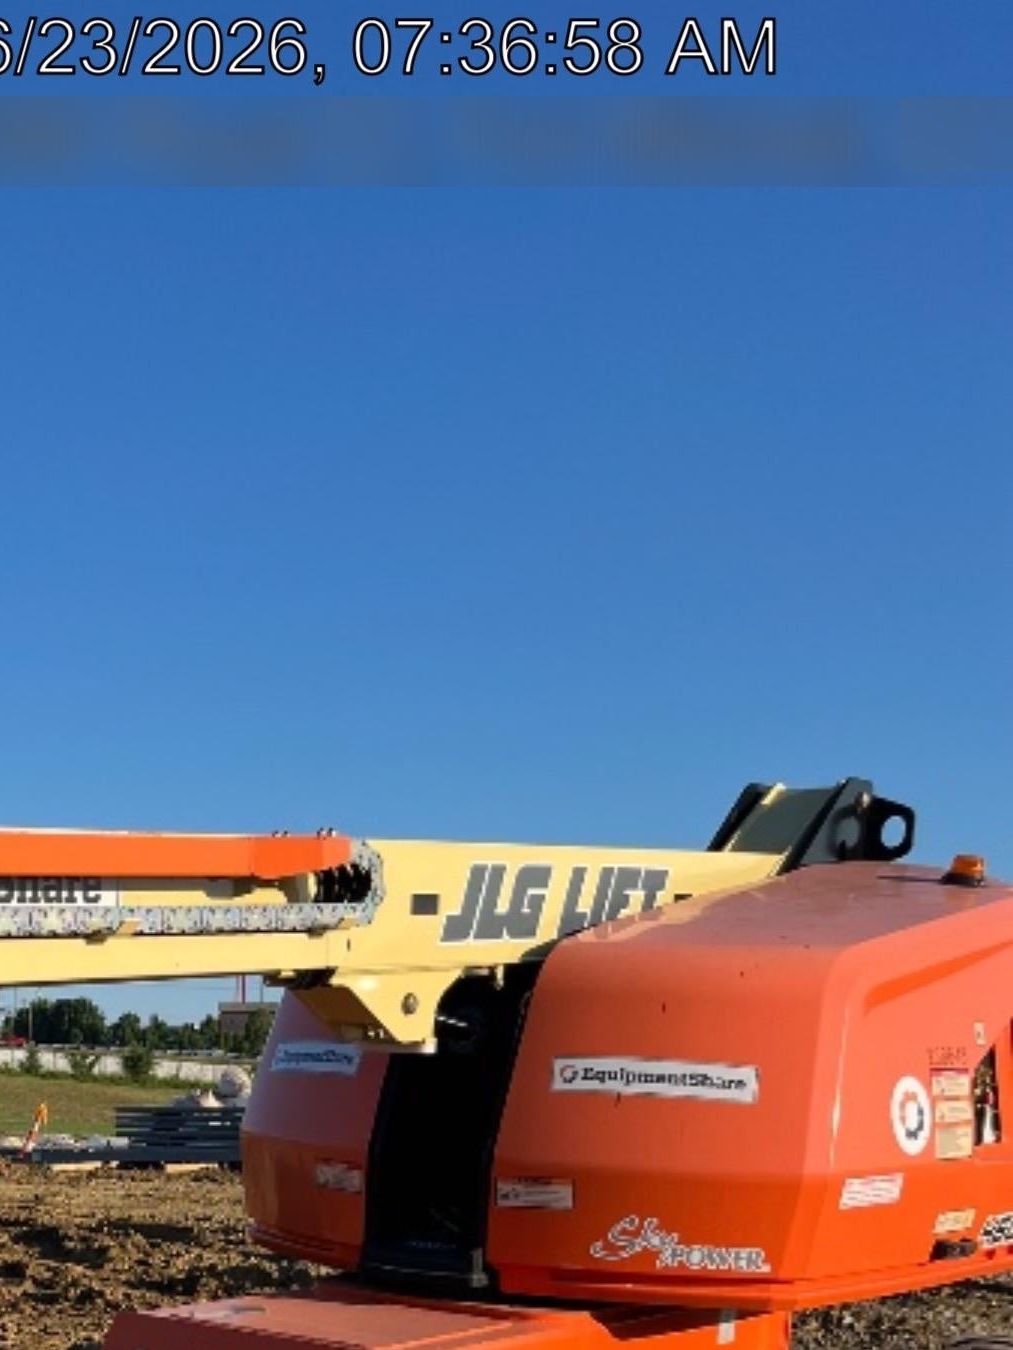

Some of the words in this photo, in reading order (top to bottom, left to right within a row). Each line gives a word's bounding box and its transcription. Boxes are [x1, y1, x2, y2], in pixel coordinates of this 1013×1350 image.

[439, 863, 553, 942] JLG
[555, 865, 670, 940] LIFT
[580, 1066, 748, 1091] EquipmentShare
